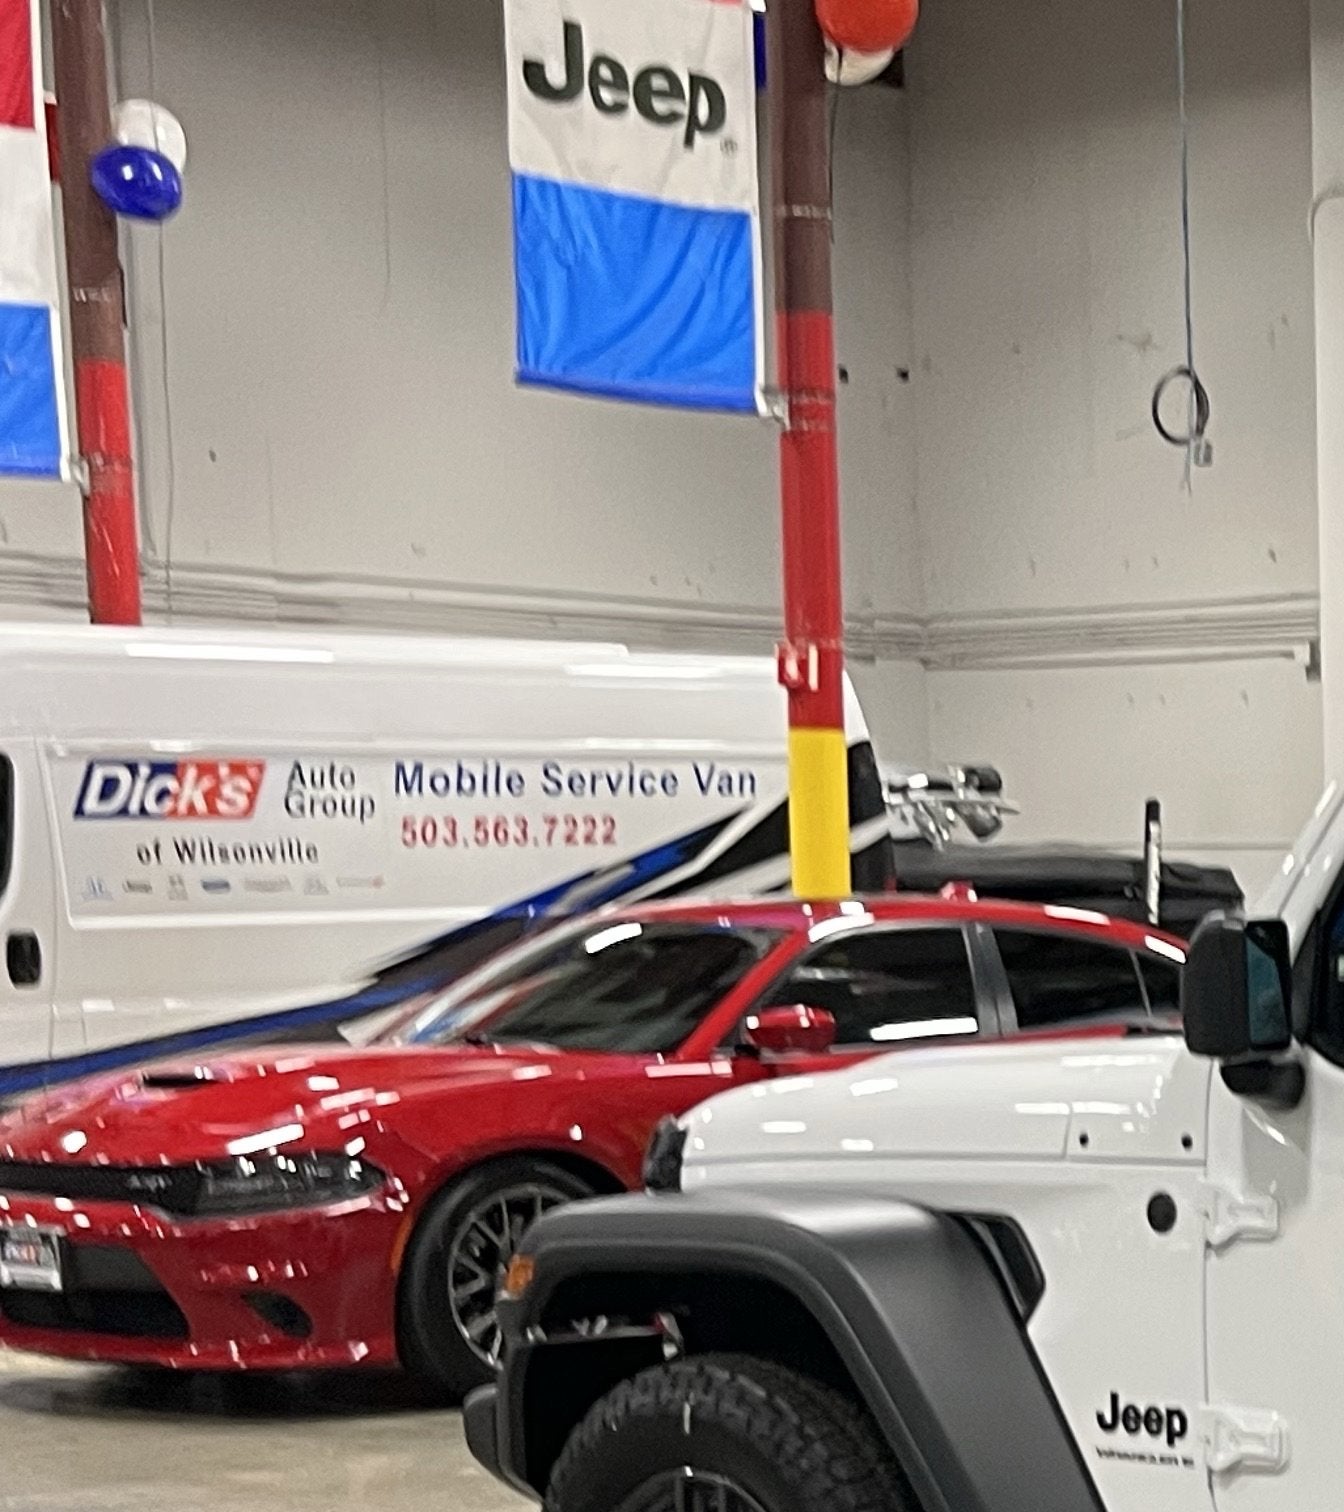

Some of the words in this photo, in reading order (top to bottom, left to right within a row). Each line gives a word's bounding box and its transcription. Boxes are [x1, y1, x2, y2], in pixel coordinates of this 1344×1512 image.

[522, 20, 727, 150] Jeep
[82, 762, 252, 818] Dick's
[287, 759, 356, 791] Auto
[393, 760, 526, 798] Mobile
[540, 761, 679, 798] Service
[692, 761, 757, 798] Van
[283, 790, 376, 824] Group
[401, 814, 617, 849] 503.563.7222
[136, 837, 163, 866] of
[173, 836, 319, 866] Wilsonville
[1095, 1390, 1188, 1448] Jeep
